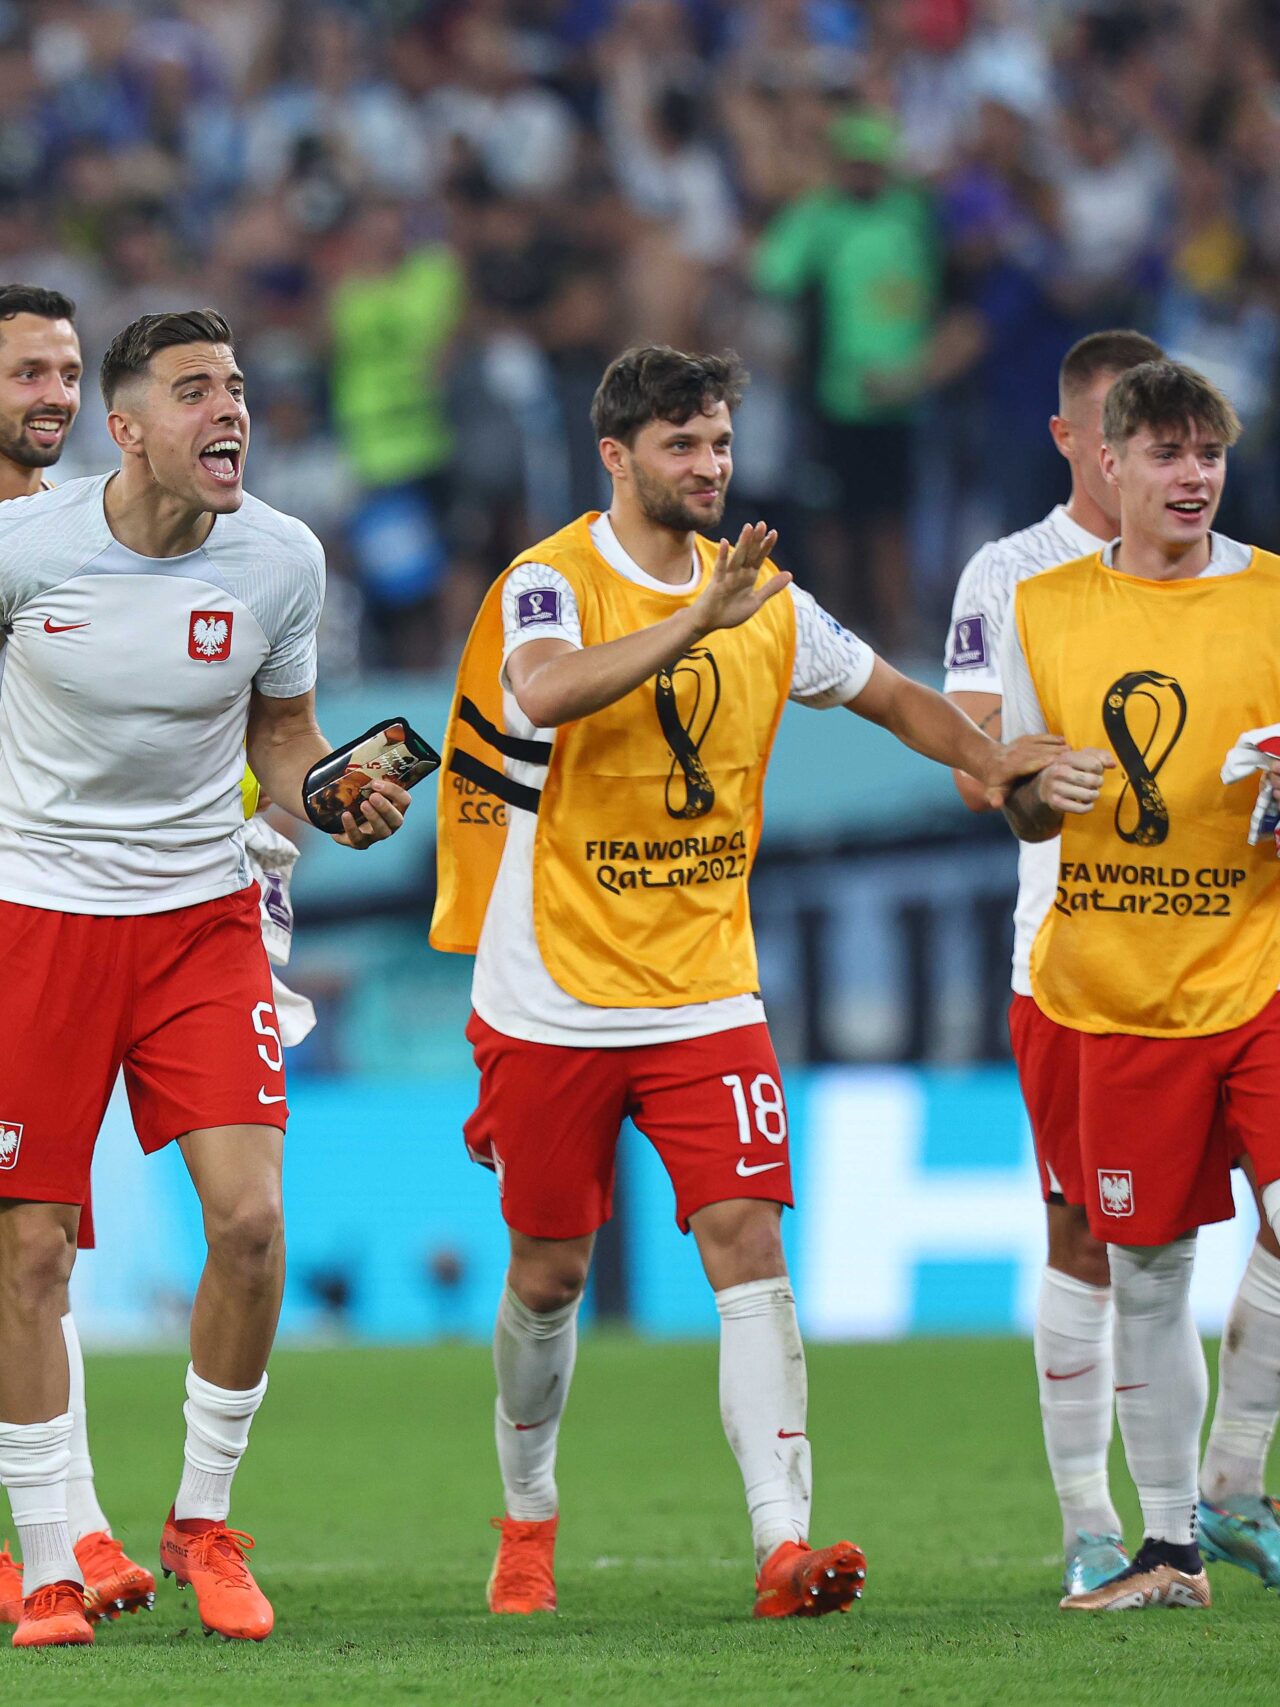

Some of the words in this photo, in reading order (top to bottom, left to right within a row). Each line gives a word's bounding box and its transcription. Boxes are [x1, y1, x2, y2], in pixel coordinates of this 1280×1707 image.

[586, 841, 639, 861] FIFA
[644, 836, 726, 860] WORLD
[1095, 863, 1190, 888] WORLD
[1195, 868, 1247, 888] CUP
[251, 1000, 283, 1072] 5
[722, 1073, 787, 1145] 18
